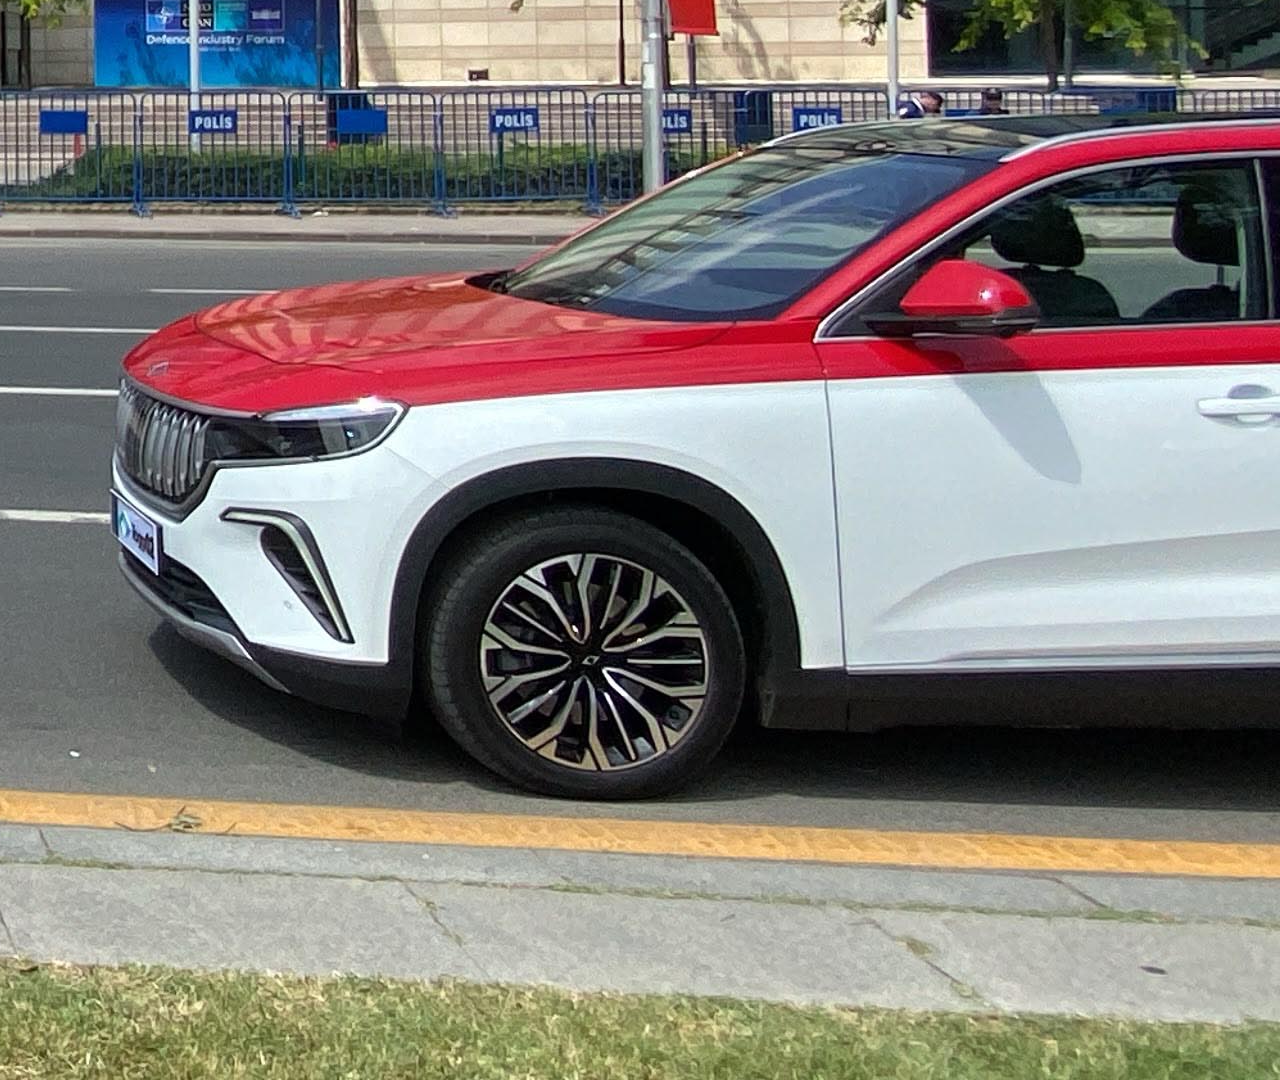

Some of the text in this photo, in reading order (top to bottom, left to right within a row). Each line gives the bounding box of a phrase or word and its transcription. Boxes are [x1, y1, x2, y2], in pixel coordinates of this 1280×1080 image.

[199, 34, 243, 46] ndustry
[246, 34, 285, 44] Forum
[662, 113, 687, 128] LİS
